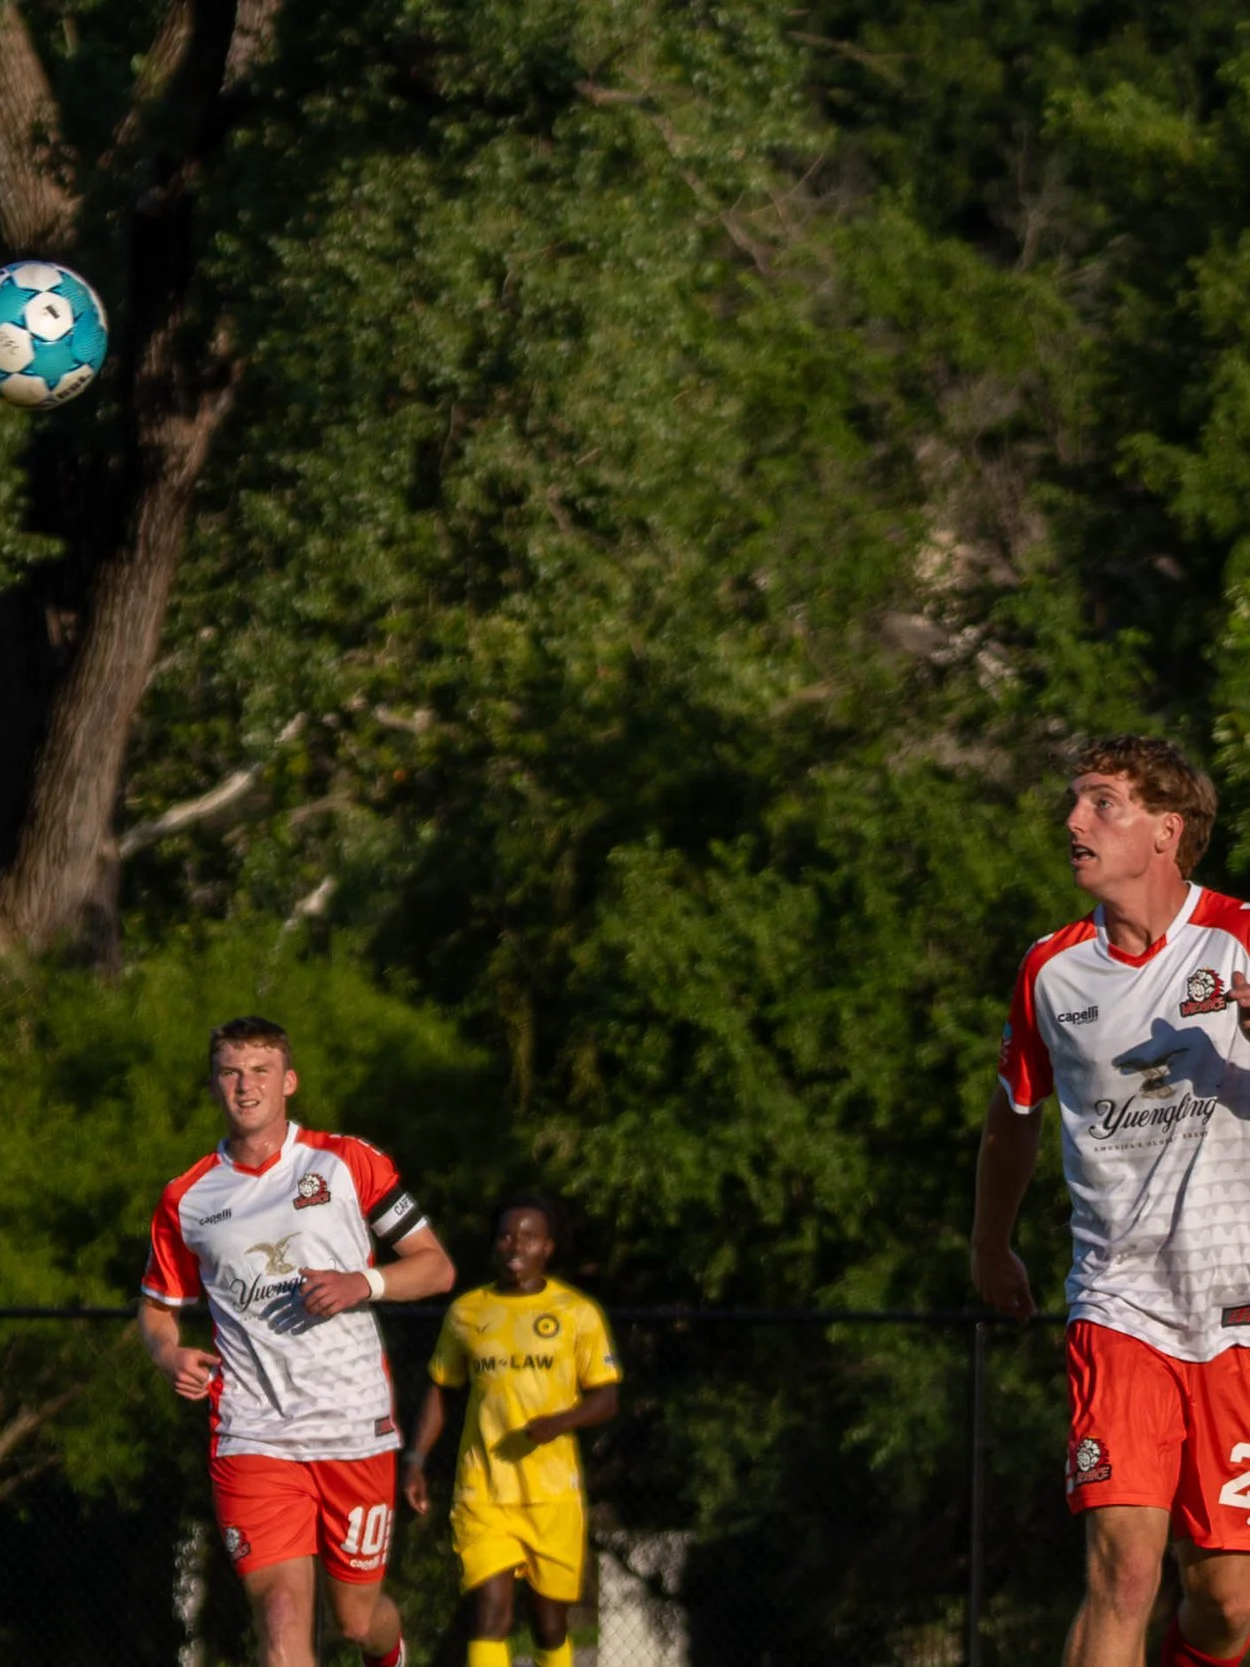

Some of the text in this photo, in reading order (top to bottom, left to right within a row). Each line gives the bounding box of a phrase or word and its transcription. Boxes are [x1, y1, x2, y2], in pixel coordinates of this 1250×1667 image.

[1057, 1005, 1099, 1025] capelli
[1088, 1092, 1218, 1140] Yuengling
[510, 1355, 554, 1370] LAW
[340, 1503, 388, 1556] 10
